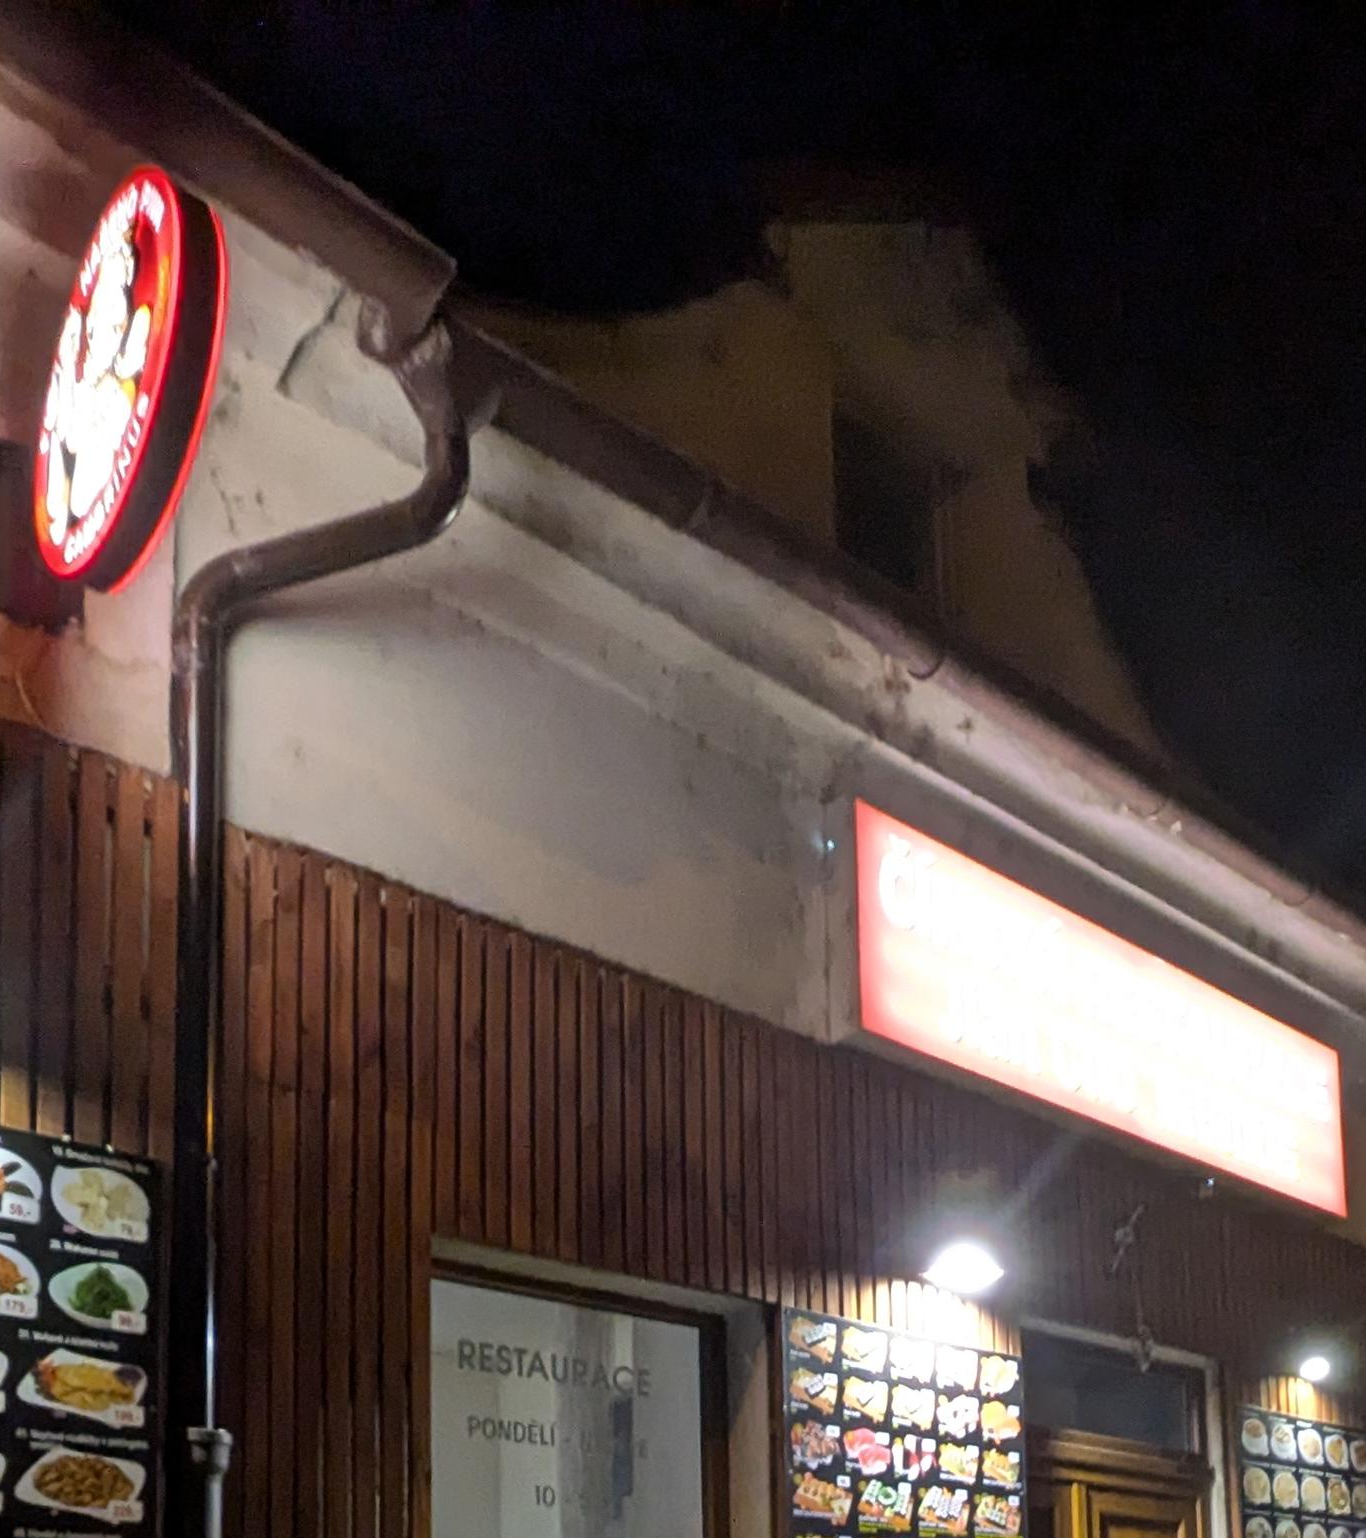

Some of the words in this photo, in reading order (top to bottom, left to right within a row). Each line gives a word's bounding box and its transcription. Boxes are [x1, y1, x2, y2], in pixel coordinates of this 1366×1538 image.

[457, 1337, 652, 1397] RESTAURACE
[467, 1414, 558, 1447] PONDĚLÍ
[534, 1484, 557, 1508] 10
